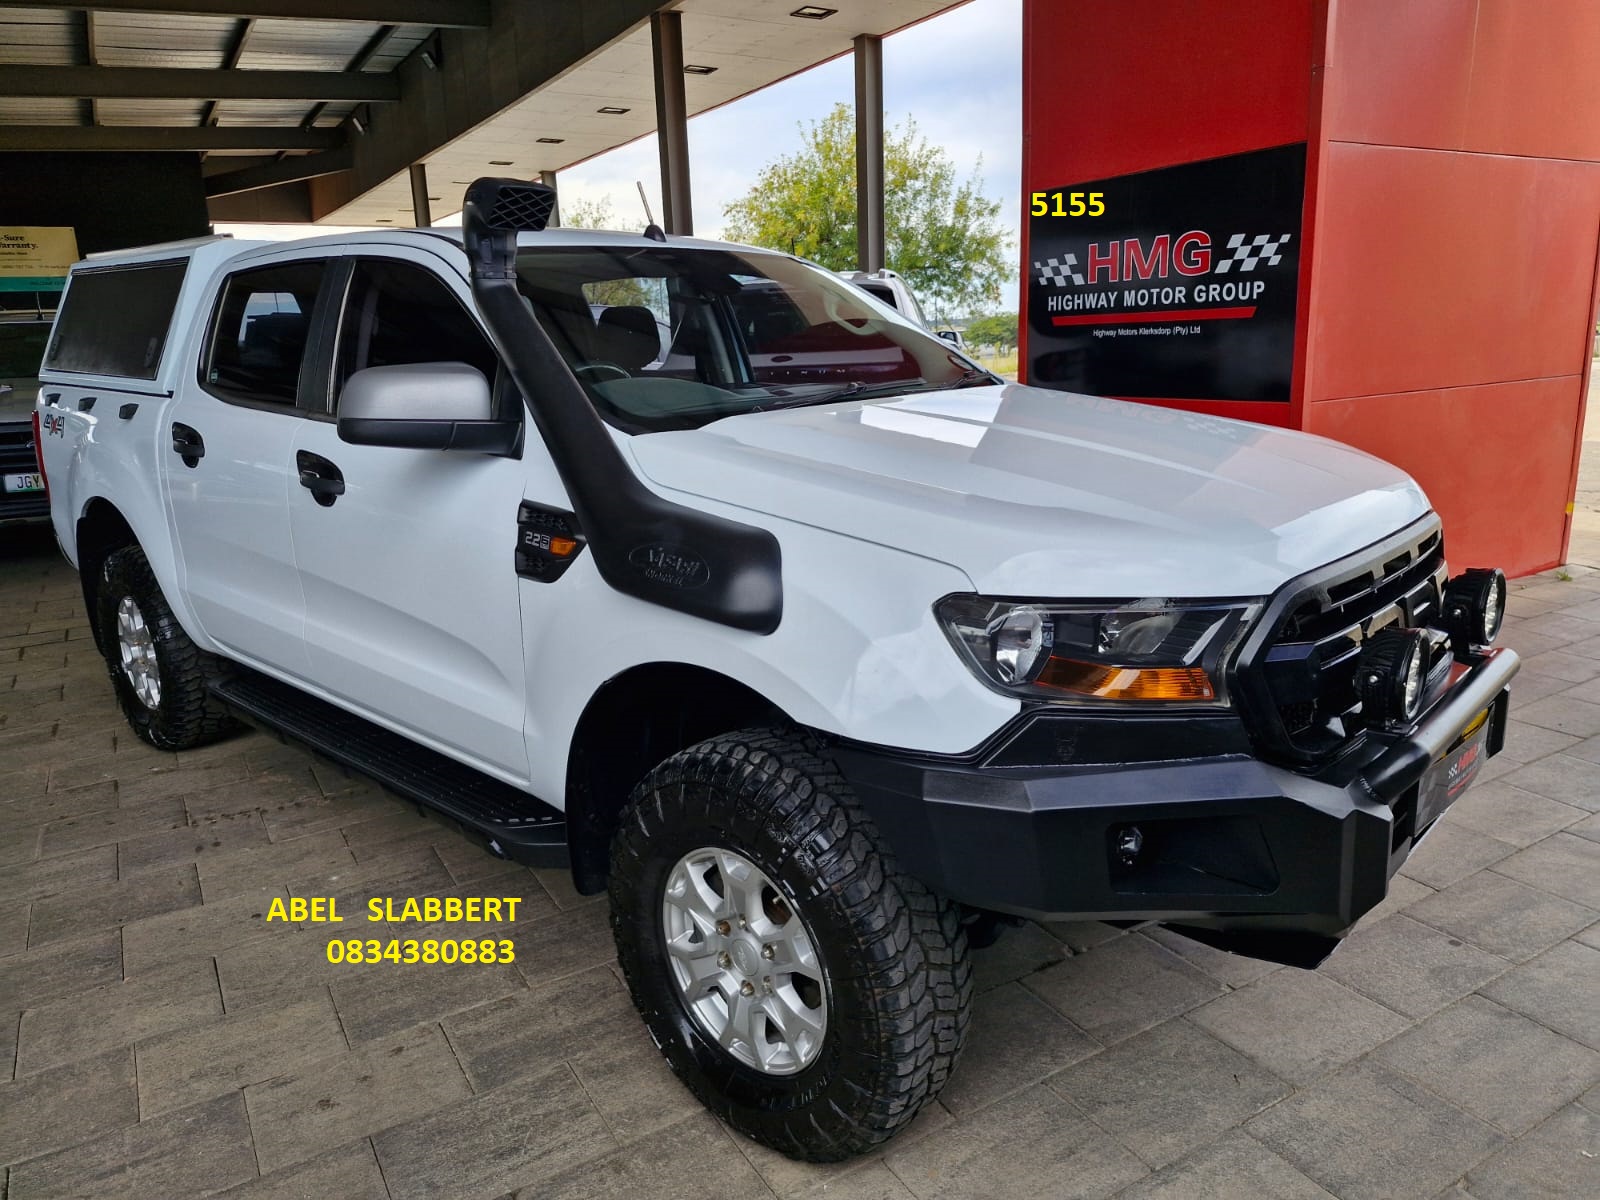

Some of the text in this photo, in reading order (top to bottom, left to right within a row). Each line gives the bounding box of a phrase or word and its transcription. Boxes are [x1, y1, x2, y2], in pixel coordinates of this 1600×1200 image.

[1087, 230, 1212, 284] HMG
[1047, 281, 1266, 312] HIGHWAY MOTOR GROUP
[1093, 325, 1201, 338] Highway Motors Klerksdorp (Pty) Ltd
